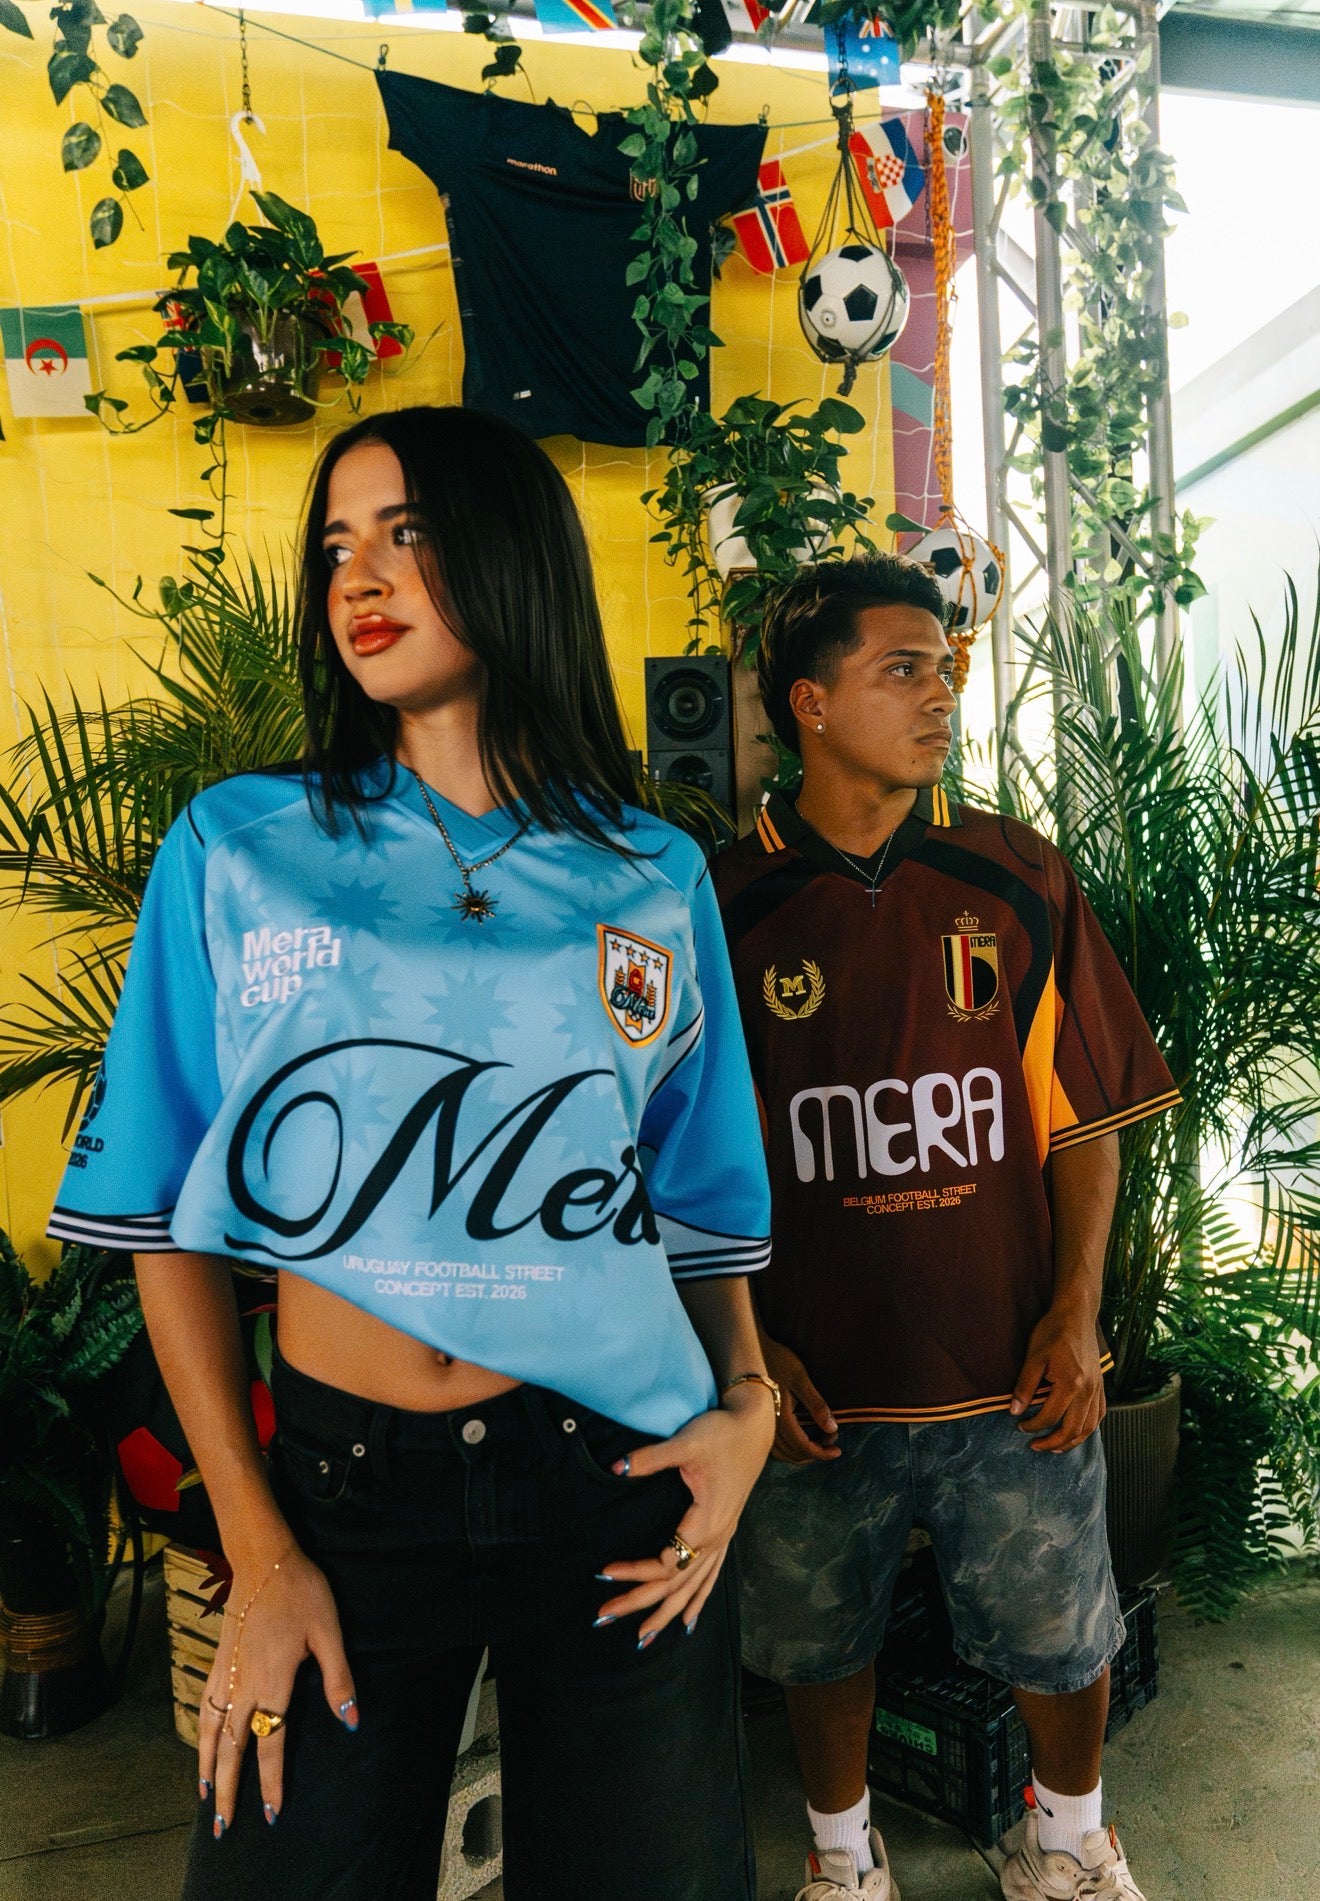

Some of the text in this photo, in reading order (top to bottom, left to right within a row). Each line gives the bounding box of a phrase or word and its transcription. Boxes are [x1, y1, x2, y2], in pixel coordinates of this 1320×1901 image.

[507, 158, 558, 176] marathon
[243, 926, 330, 961] Mera
[970, 936, 996, 948] MERA
[242, 938, 341, 985] world
[241, 974, 302, 1007] cup
[779, 975, 806, 997] M
[789, 1067, 1005, 1183] MERA
[74, 1134, 104, 1152] ORLD
[843, 1183, 977, 1207] BELGIUM FOOTBALL STREET
[866, 1196, 961, 1215] CONCEPT EST. 2026
[343, 1255, 565, 1281] URUGUAY FOOTBALL STREET
[374, 1279, 527, 1300] CONCEPT EST. 2026
